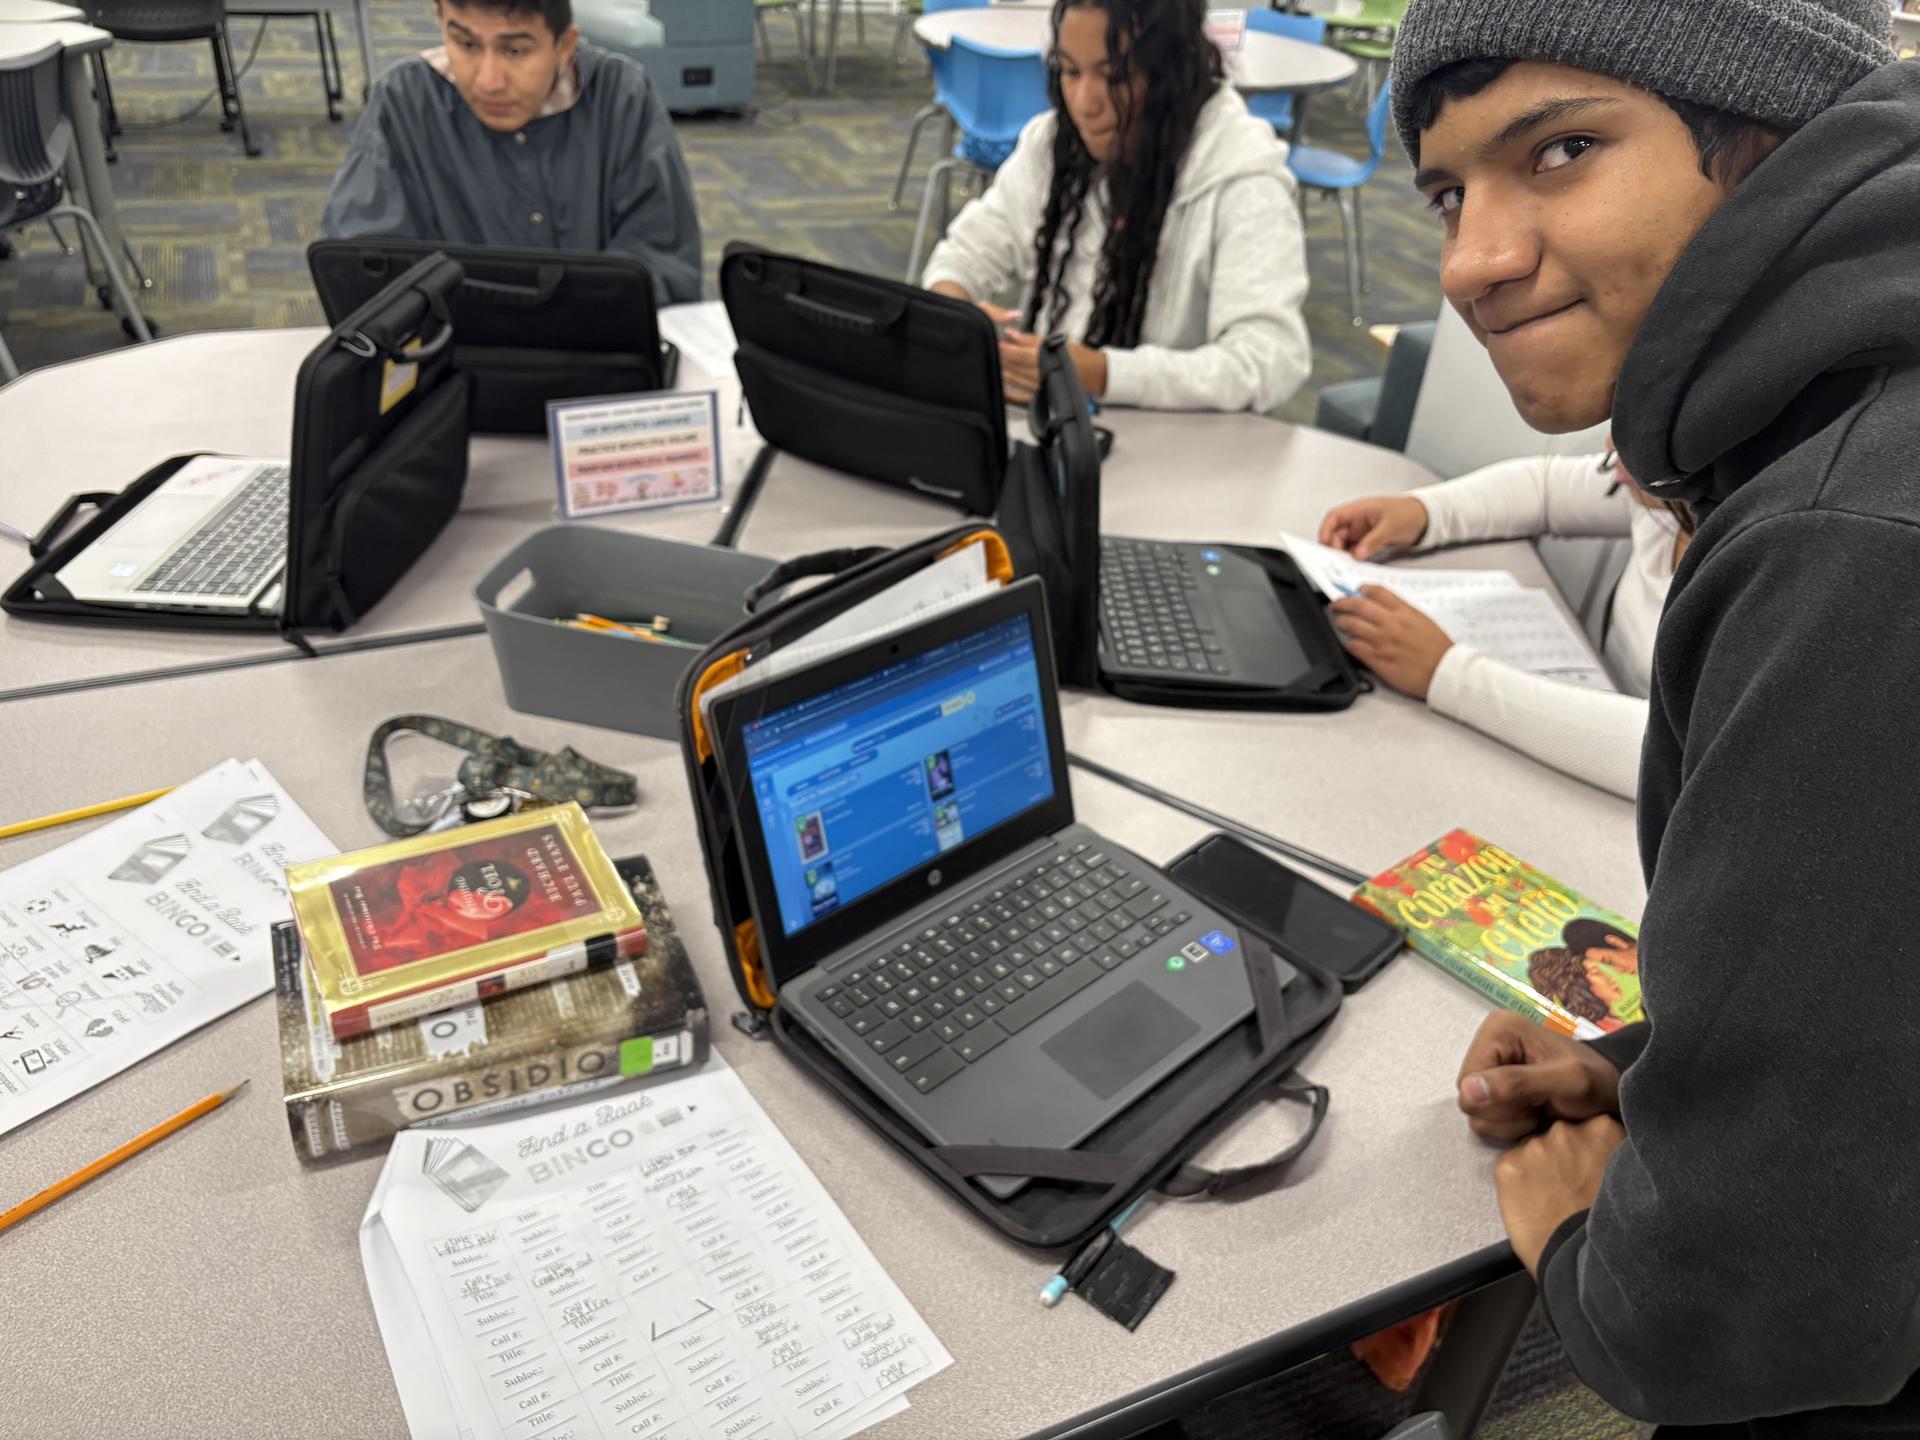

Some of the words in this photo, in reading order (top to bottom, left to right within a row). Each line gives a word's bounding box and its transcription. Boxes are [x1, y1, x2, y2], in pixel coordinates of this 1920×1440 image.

[526, 848, 562, 902] RICHARD
[541, 834, 570, 872] EVANS
[146, 891, 209, 936] BINGO
[563, 874, 587, 906] PAUL
[412, 1051, 605, 1112] OBSIDIO
[517, 1124, 568, 1158] Find
[573, 1122, 591, 1138] a
[595, 1093, 653, 1126] Book
[527, 1129, 634, 1184] BINGO
[518, 1394, 540, 1409] Call
